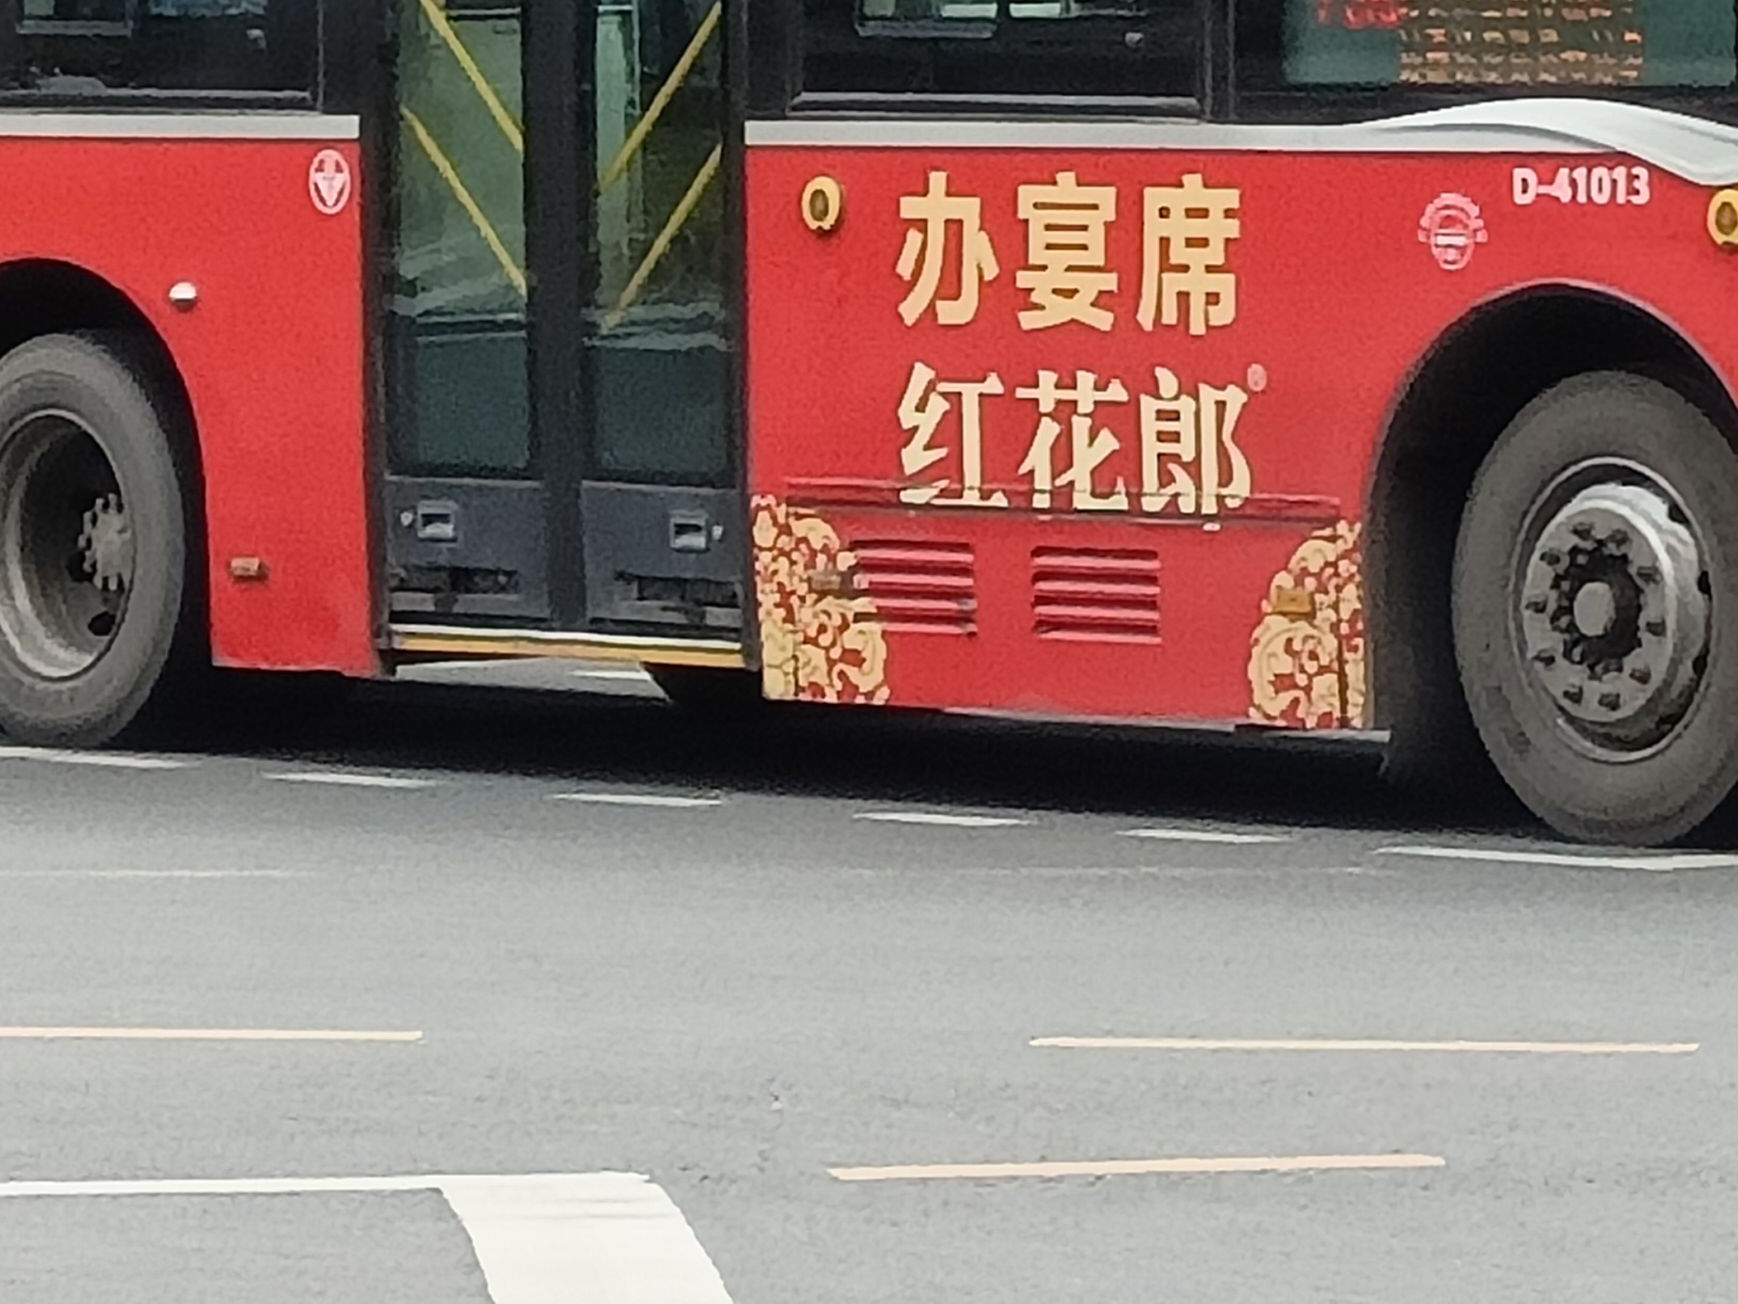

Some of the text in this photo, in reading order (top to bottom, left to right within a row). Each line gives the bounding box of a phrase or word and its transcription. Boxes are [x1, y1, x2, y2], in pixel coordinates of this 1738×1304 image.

[895, 171, 1241, 336] 办宴席
[1511, 165, 1651, 205] D-41013
[897, 362, 1252, 518] 红花郎
